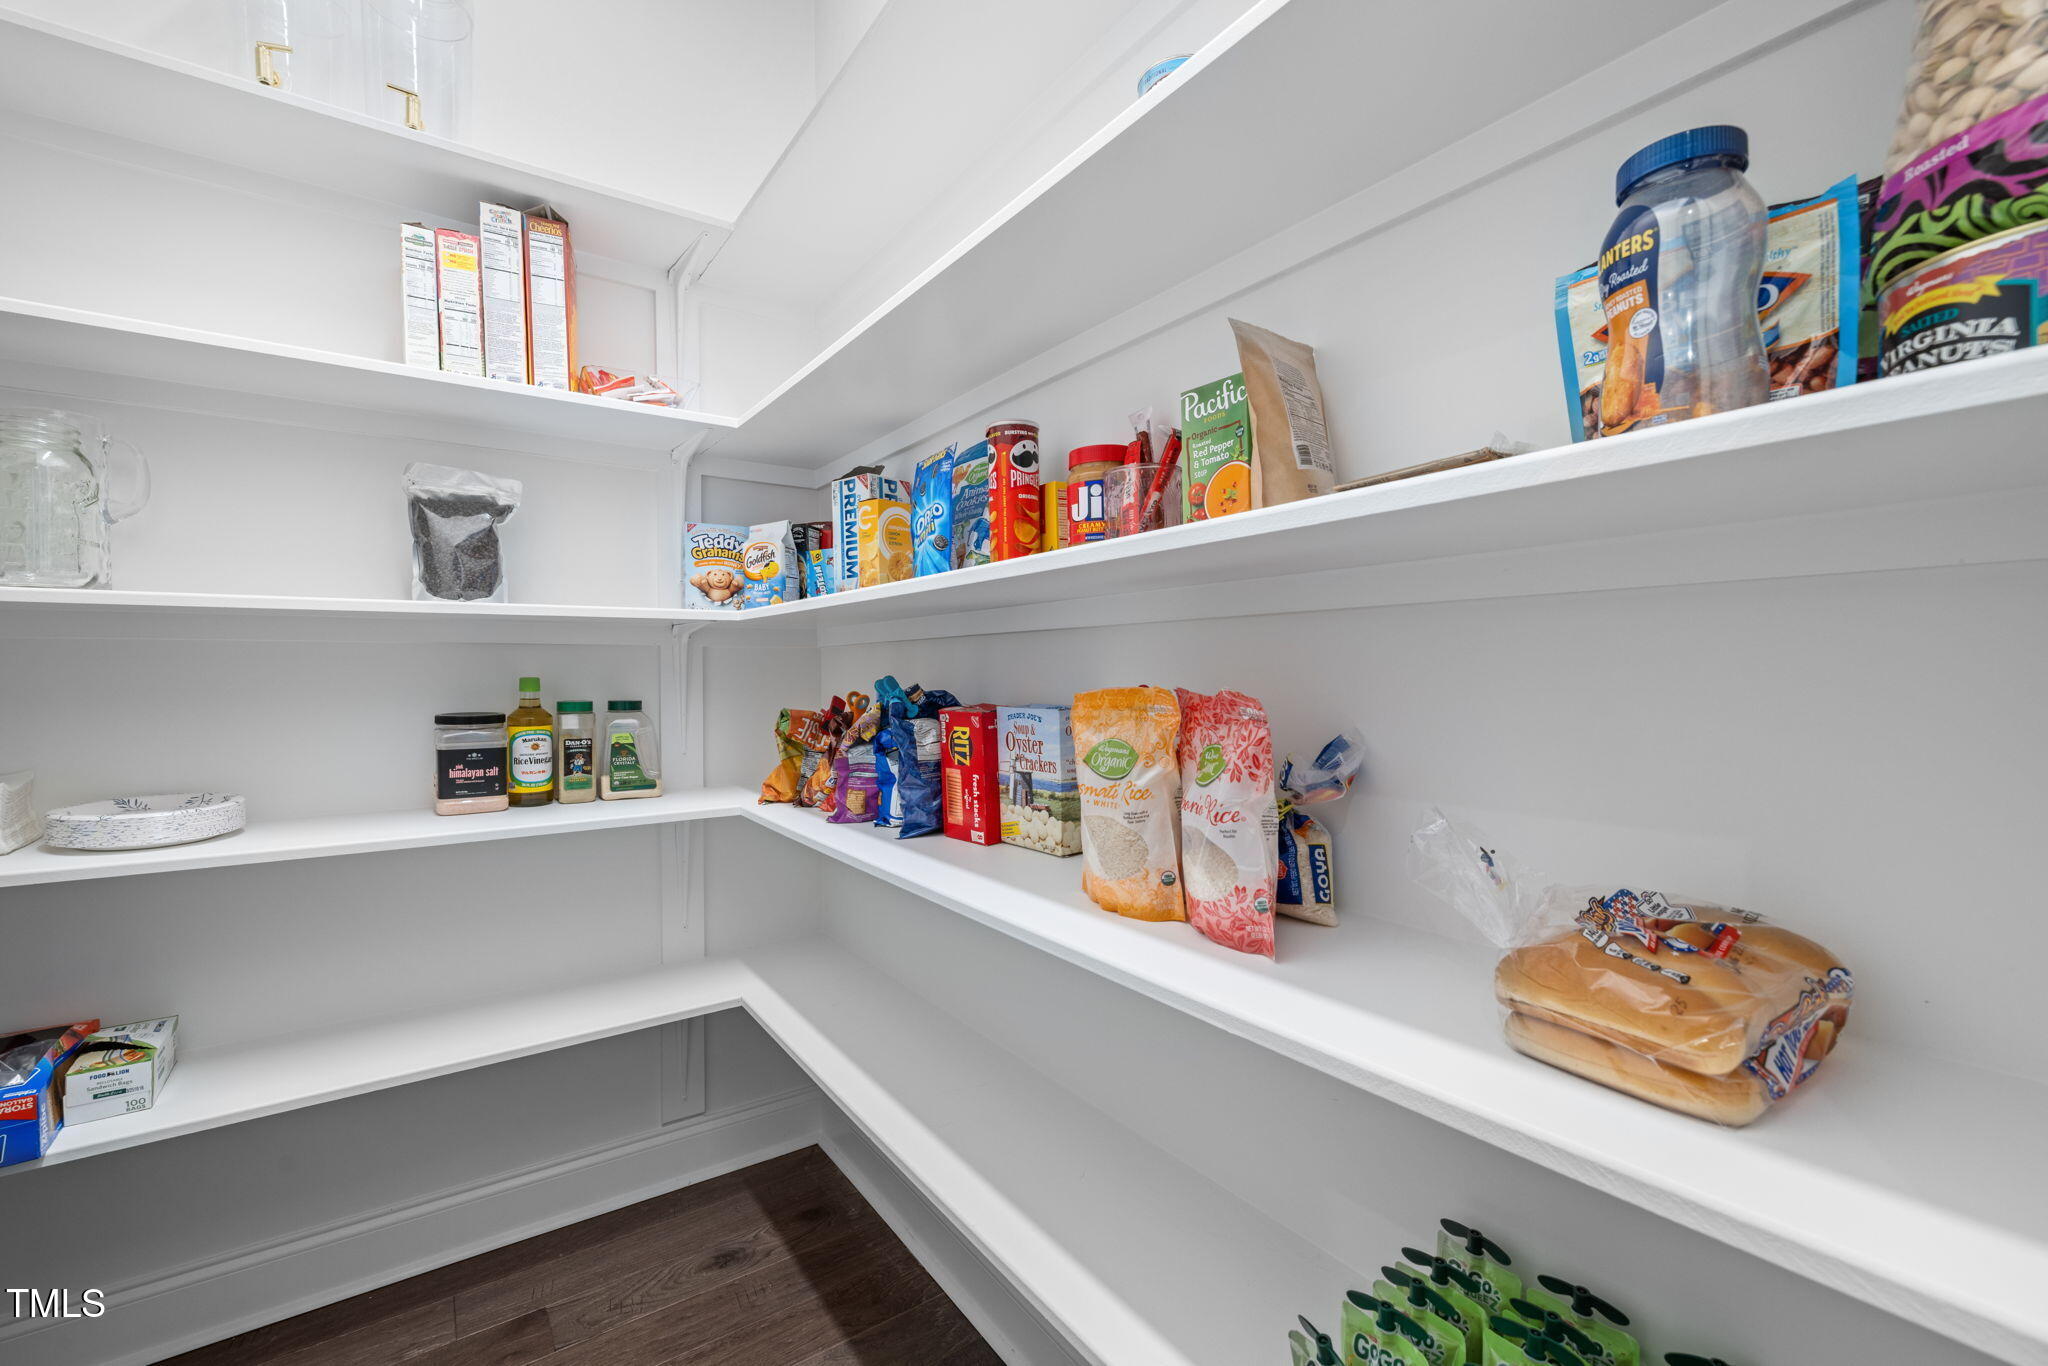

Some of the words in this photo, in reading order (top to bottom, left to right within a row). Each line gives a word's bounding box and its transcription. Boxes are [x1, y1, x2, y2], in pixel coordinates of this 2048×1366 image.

[529, 221, 563, 237] Cheerios
[1600, 229, 1654, 272] ANTERS
[1609, 258, 1649, 288] Roasted
[1901, 308, 1959, 335] SALTED
[1180, 380, 1248, 422] Pacific
[1191, 427, 1218, 440] Organic
[1193, 445, 1208, 459] Red
[1210, 439, 1235, 454] Pepper
[1194, 461, 1199, 469] &
[1201, 451, 1230, 467] Tomato
[1010, 469, 1040, 490] PRINGLE
[1071, 484, 1103, 522] Ji
[843, 478, 859, 579] PREMIUM
[916, 503, 943, 535] OREO
[691, 533, 744, 551] Teddy
[691, 547, 745, 563] Grahams
[746, 549, 777, 569] Goldfish
[1007, 713, 1026, 721] TRADER
[1027, 713, 1042, 722] JOE'S
[1013, 721, 1029, 736] Soup
[1030, 724, 1036, 736] &
[953, 726, 970, 766] RITZ
[1006, 731, 1044, 755] Oyster
[513, 757, 529, 765] Rice
[1019, 755, 1057, 775] Crackers
[1091, 752, 1132, 772] Organic
[449, 768, 484, 779] himalayan
[486, 766, 499, 776] salt
[972, 774, 980, 797] fresh
[1078, 782, 1120, 800] smati
[1122, 780, 1152, 806] Rice
[973, 800, 981, 828] stacks
[1206, 794, 1240, 827] Rice
[1314, 848, 1330, 902] GOYA
[87, 1083, 117, 1092] Sandwich
[126, 1098, 146, 1107] 100
[126, 1104, 146, 1112] BAGS
